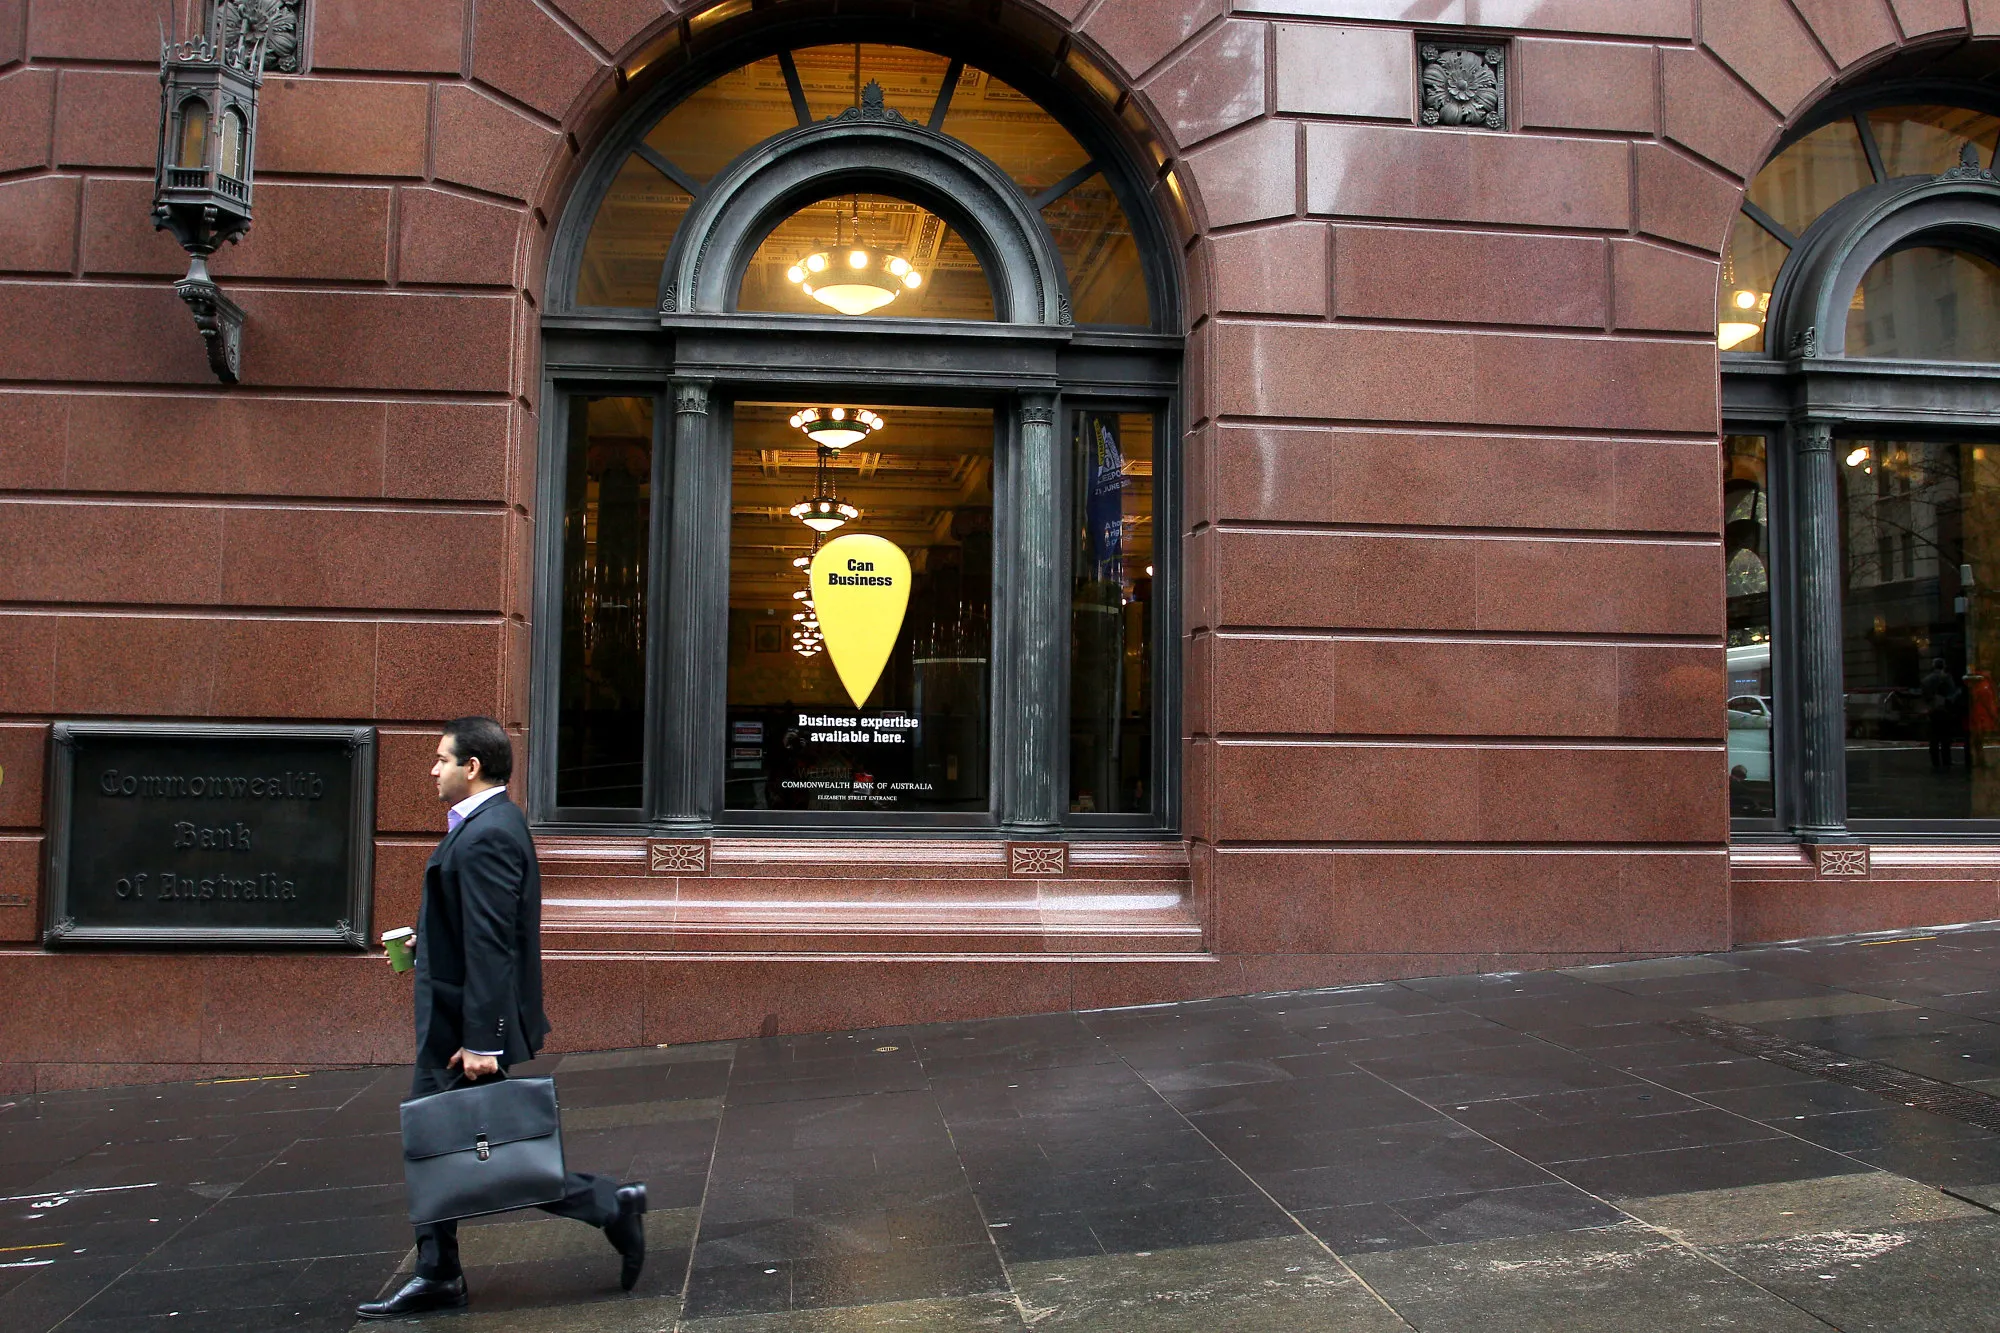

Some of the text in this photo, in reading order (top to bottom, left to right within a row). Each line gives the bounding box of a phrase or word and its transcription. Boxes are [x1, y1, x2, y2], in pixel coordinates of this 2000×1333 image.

[1103, 482, 1121, 493] JUNE
[847, 558, 874, 572] Can
[828, 572, 893, 587] Business
[798, 714, 919, 730] Business expertise
[810, 730, 906, 744] available here.
[99, 768, 324, 800] Commonwealth
[781, 781, 850, 789] COMMONWEALTH
[890, 782, 933, 790] AUSTRALIA
[173, 820, 253, 851] Bank
[114, 871, 297, 901] of Australia
